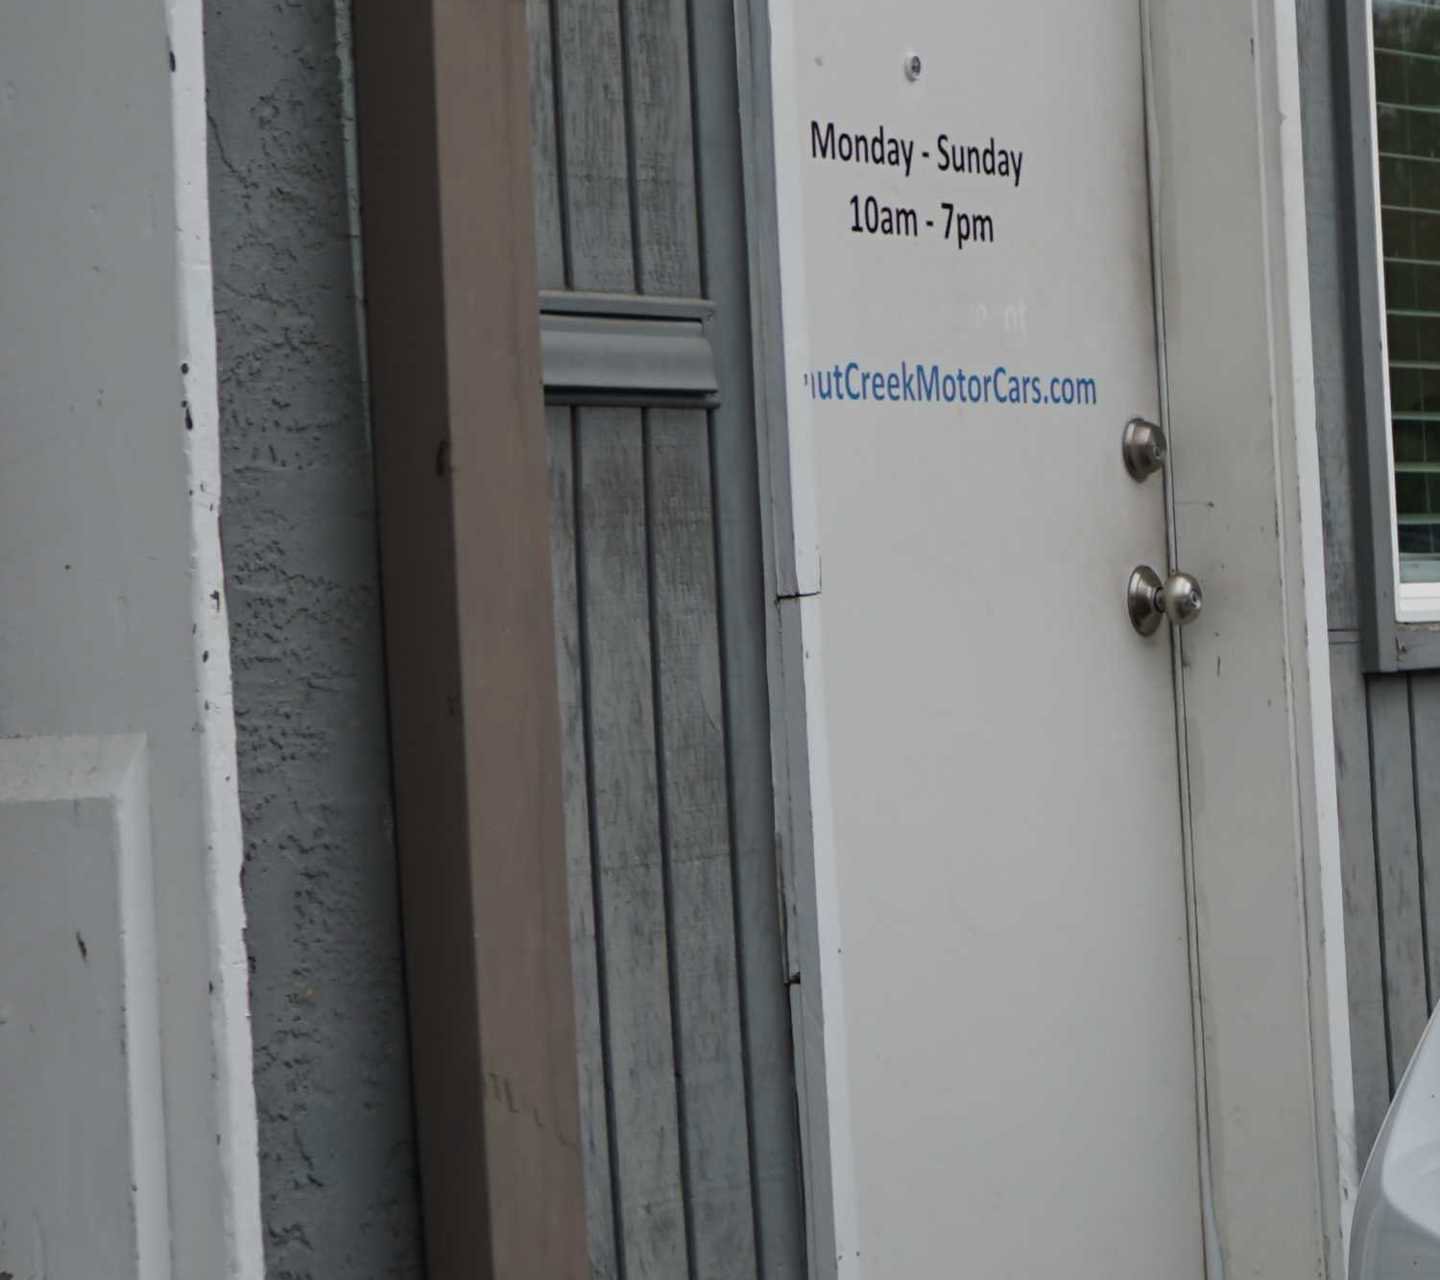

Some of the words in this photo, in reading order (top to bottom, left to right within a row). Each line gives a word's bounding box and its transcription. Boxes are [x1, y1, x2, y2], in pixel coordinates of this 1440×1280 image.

[811, 121, 914, 176] Monday
[937, 134, 1024, 187] Sunday
[849, 195, 918, 238] 10am
[940, 203, 994, 249] 7pm
